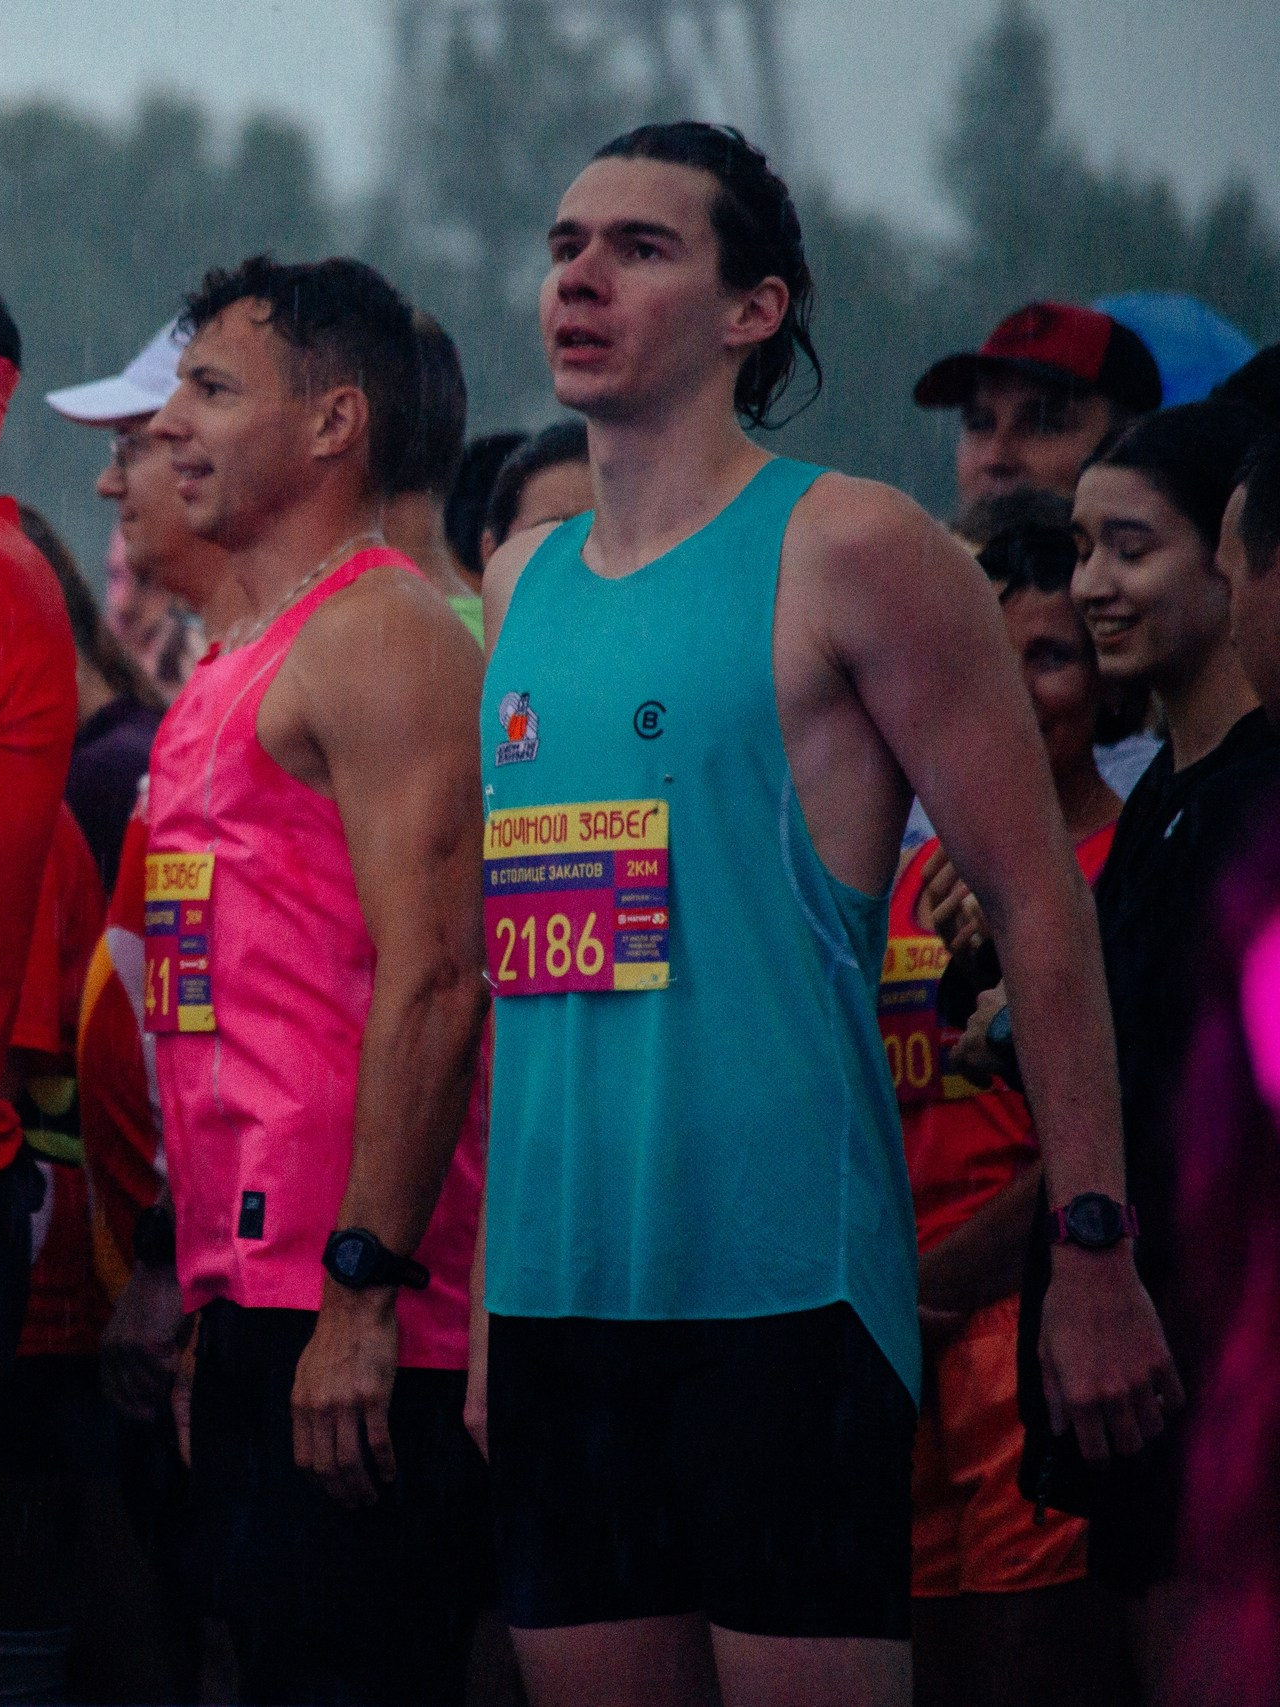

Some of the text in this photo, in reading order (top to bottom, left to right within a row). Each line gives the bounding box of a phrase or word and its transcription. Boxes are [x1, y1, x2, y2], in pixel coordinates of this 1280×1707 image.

[490, 808, 658, 849] НОЧНОЙ ЗАБЕГ
[490, 862, 603, 886] В СТОЛИЦЕ ЗАКАТОВ
[495, 911, 606, 982] 2186
